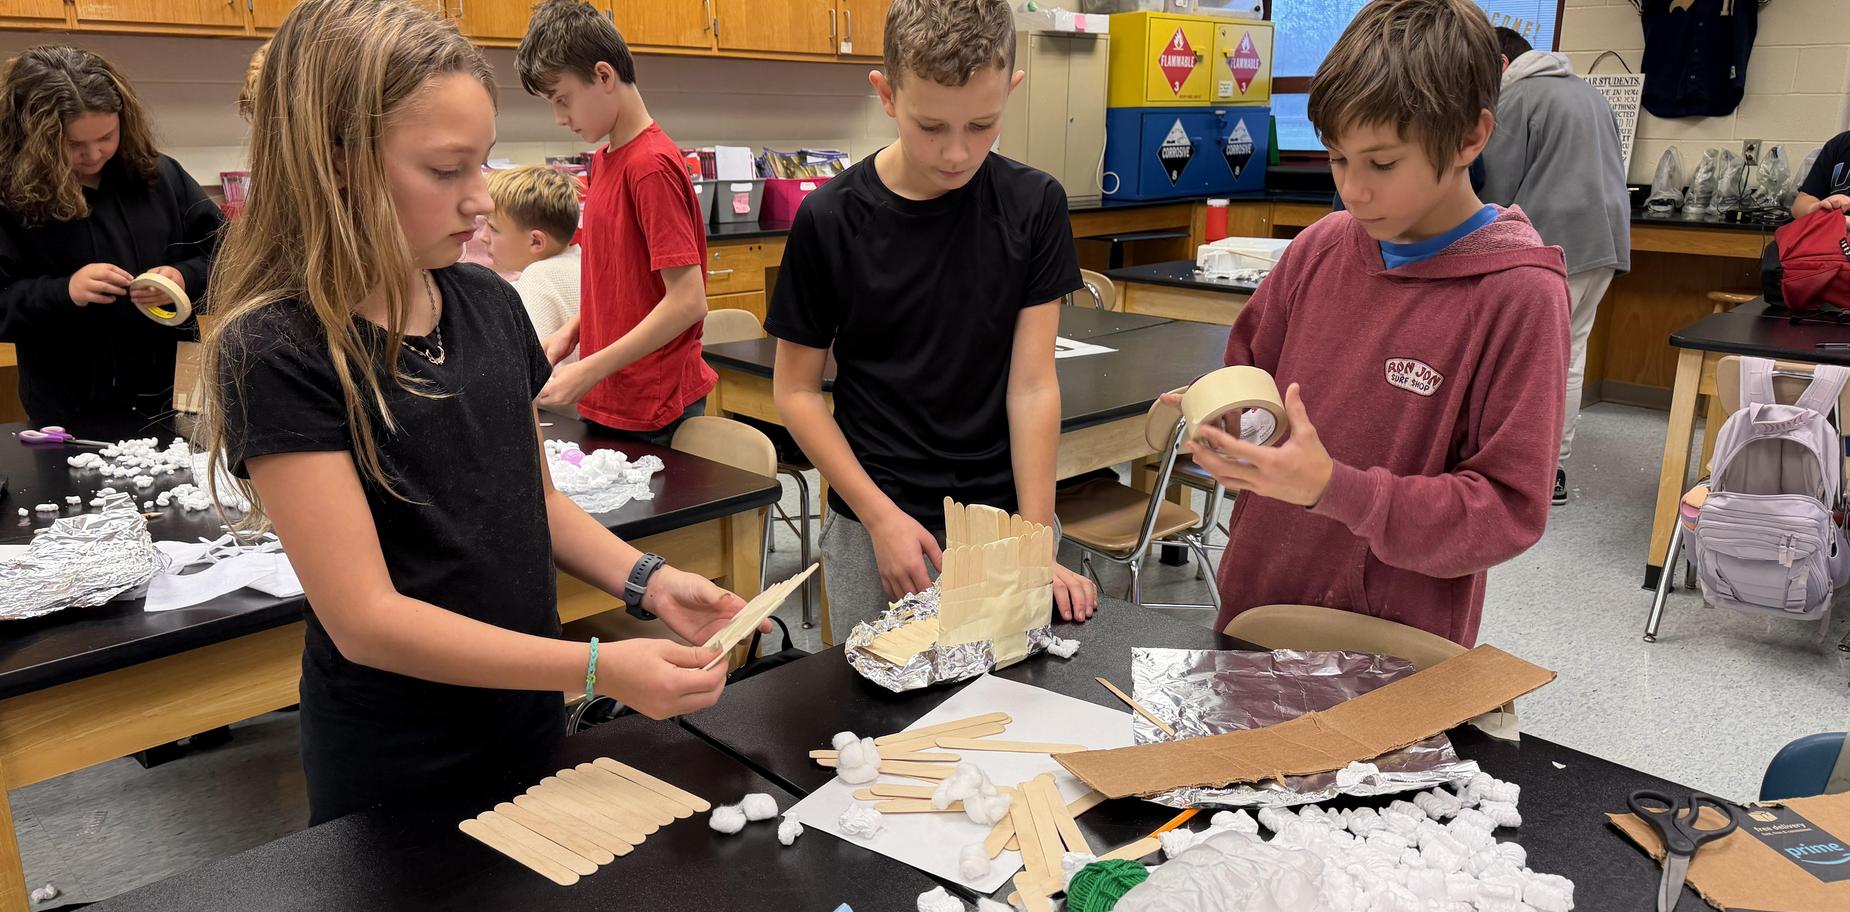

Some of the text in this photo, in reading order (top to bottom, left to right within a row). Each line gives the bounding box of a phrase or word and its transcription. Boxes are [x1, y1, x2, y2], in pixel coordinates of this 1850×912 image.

[1491, 12, 1541, 39] COME!
[1161, 55, 1195, 68] FLAMMABLE
[1230, 57, 1260, 69] FLAMMABLE
[1174, 81, 1180, 92] 3
[1241, 82, 1247, 92] 3
[1162, 146, 1190, 159] CORROSIVE
[1226, 143, 1252, 156] CORROSIVE
[1172, 170, 1178, 180] 8
[1235, 166, 1240, 175] 8
[1388, 362, 1441, 386] RON JON
[1391, 373, 1430, 392] SURF SHOP
[1772, 822, 1807, 830] delivery
[1784, 843, 1844, 859] prime
